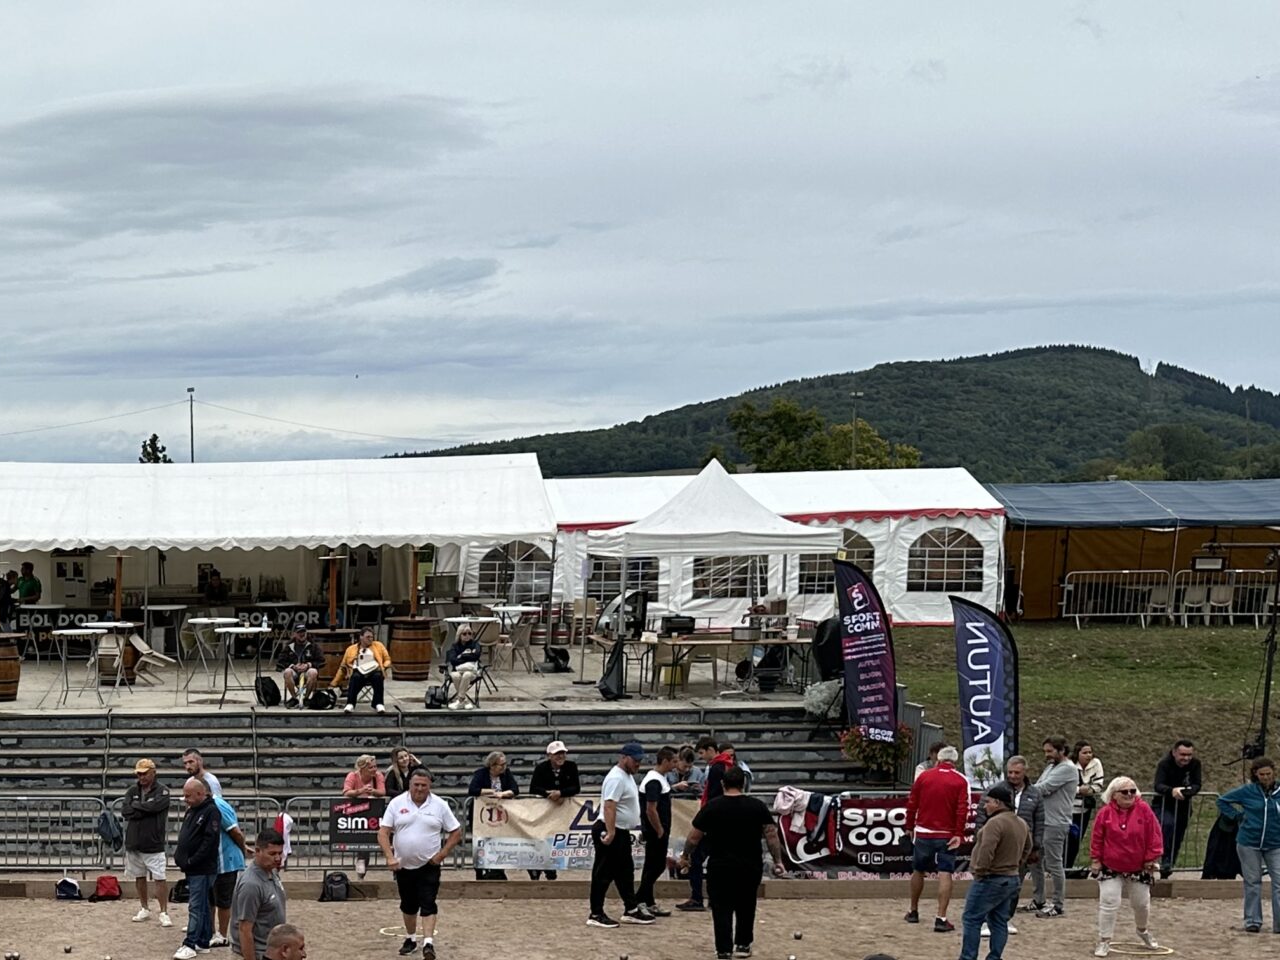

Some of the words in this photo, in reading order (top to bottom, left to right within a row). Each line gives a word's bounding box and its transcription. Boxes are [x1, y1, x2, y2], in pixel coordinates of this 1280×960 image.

[19, 613, 52, 627] BOL
[843, 611, 880, 625] SPORT
[847, 620, 880, 634] COMM
[842, 807, 908, 827] SPO
